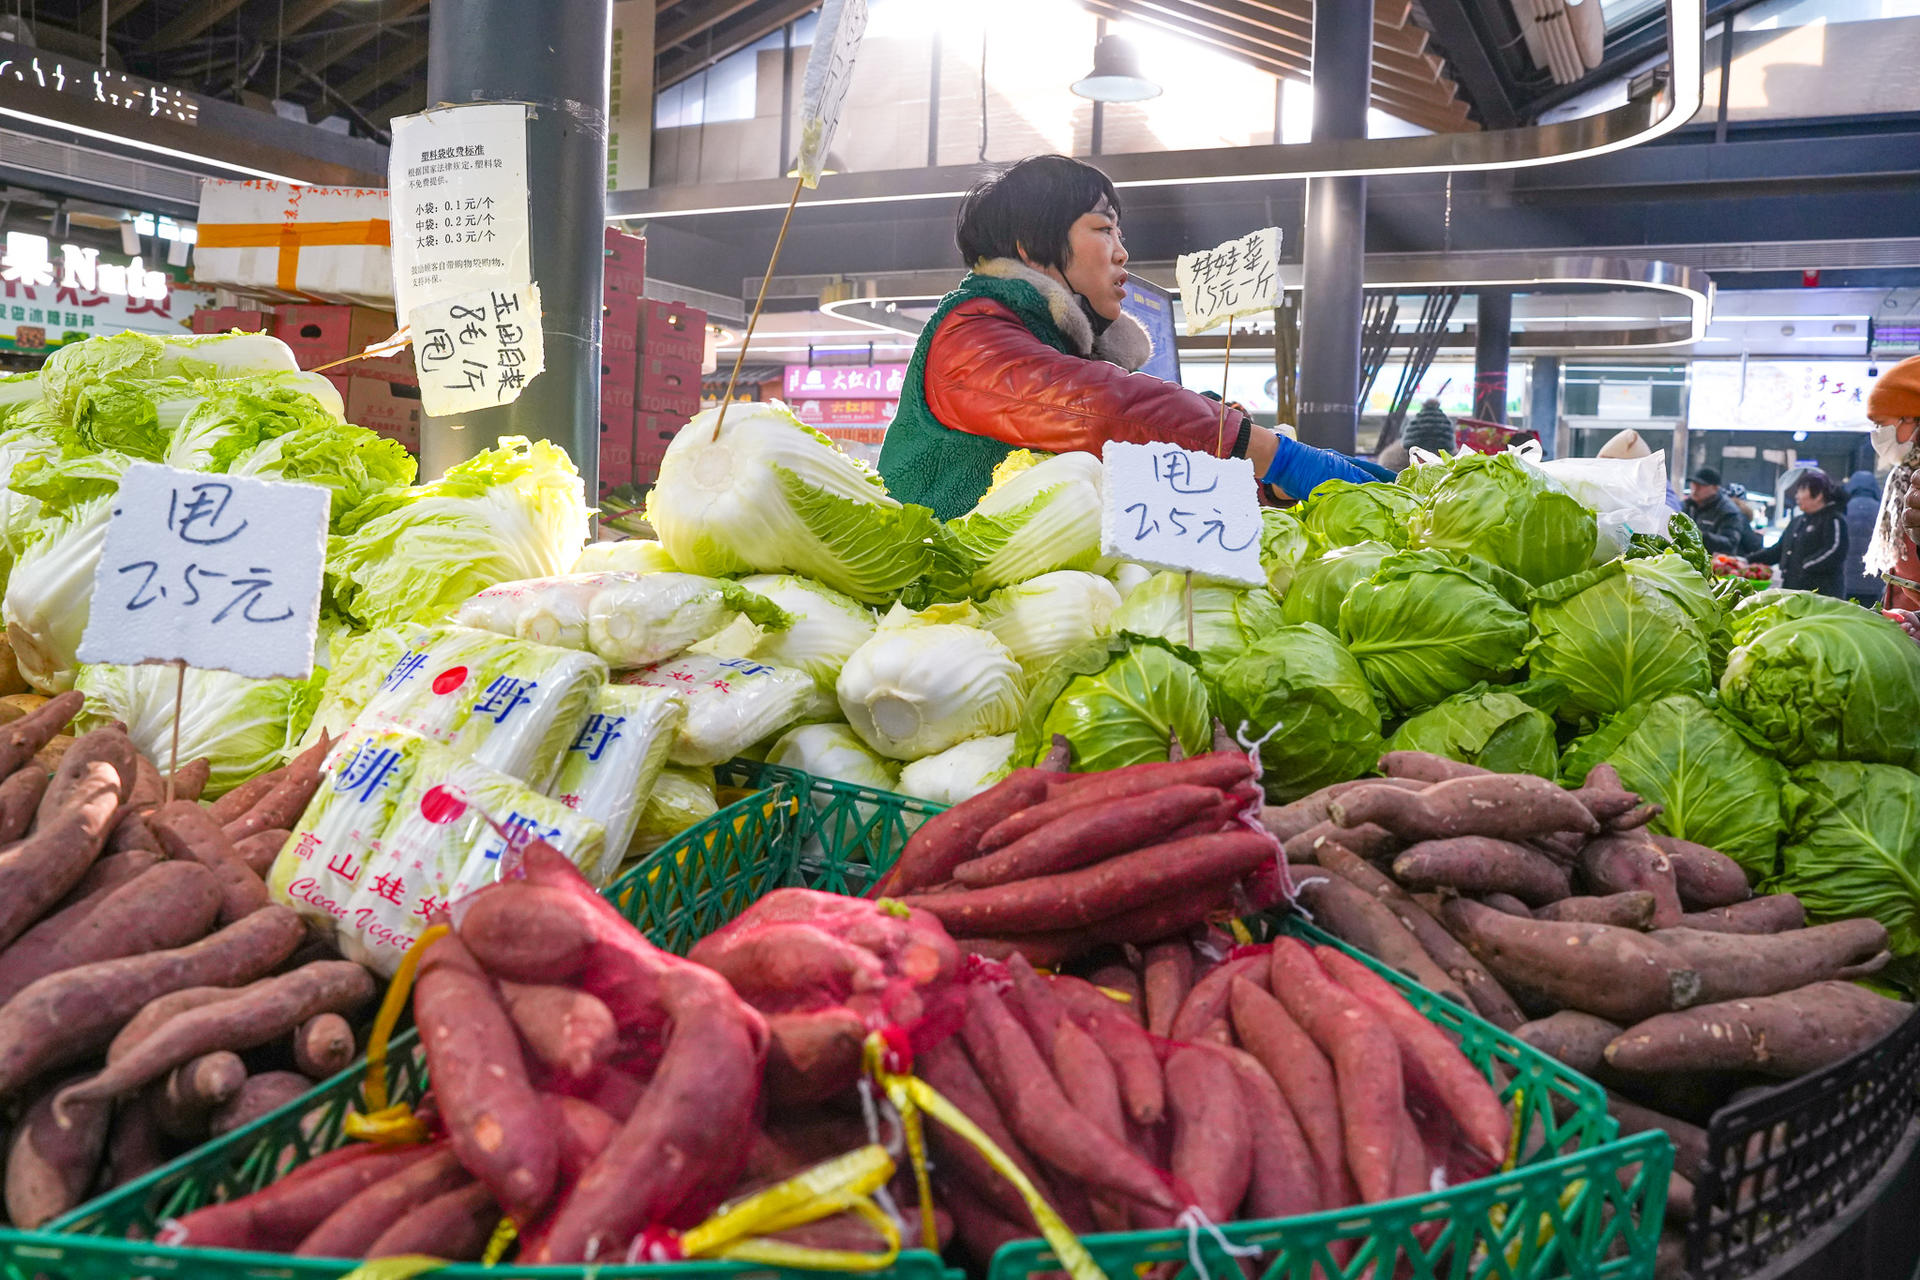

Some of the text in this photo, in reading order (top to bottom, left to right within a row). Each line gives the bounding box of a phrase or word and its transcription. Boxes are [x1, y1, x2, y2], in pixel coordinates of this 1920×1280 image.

[421, 144, 485, 161] 塑料袋收费标准
[60, 243, 168, 300] Nuts
[1190, 235, 1265, 284] 娃娃菜
[1194, 260, 1274, 317] 1.5元一斤
[491, 291, 526, 403] 玉田白菜
[647, 340, 703, 363] TOMATO
[642, 395, 699, 415] TOMATO
[1153, 450, 1219, 494] 甩
[168, 482, 249, 546] 甩
[1124, 502, 1260, 552] 2.5元
[118, 560, 295, 625] 2.5元
[473, 674, 538, 724] 野
[568, 713, 626, 761] 野
[334, 737, 402, 803] 耕
[355, 908, 417, 951] Veget
